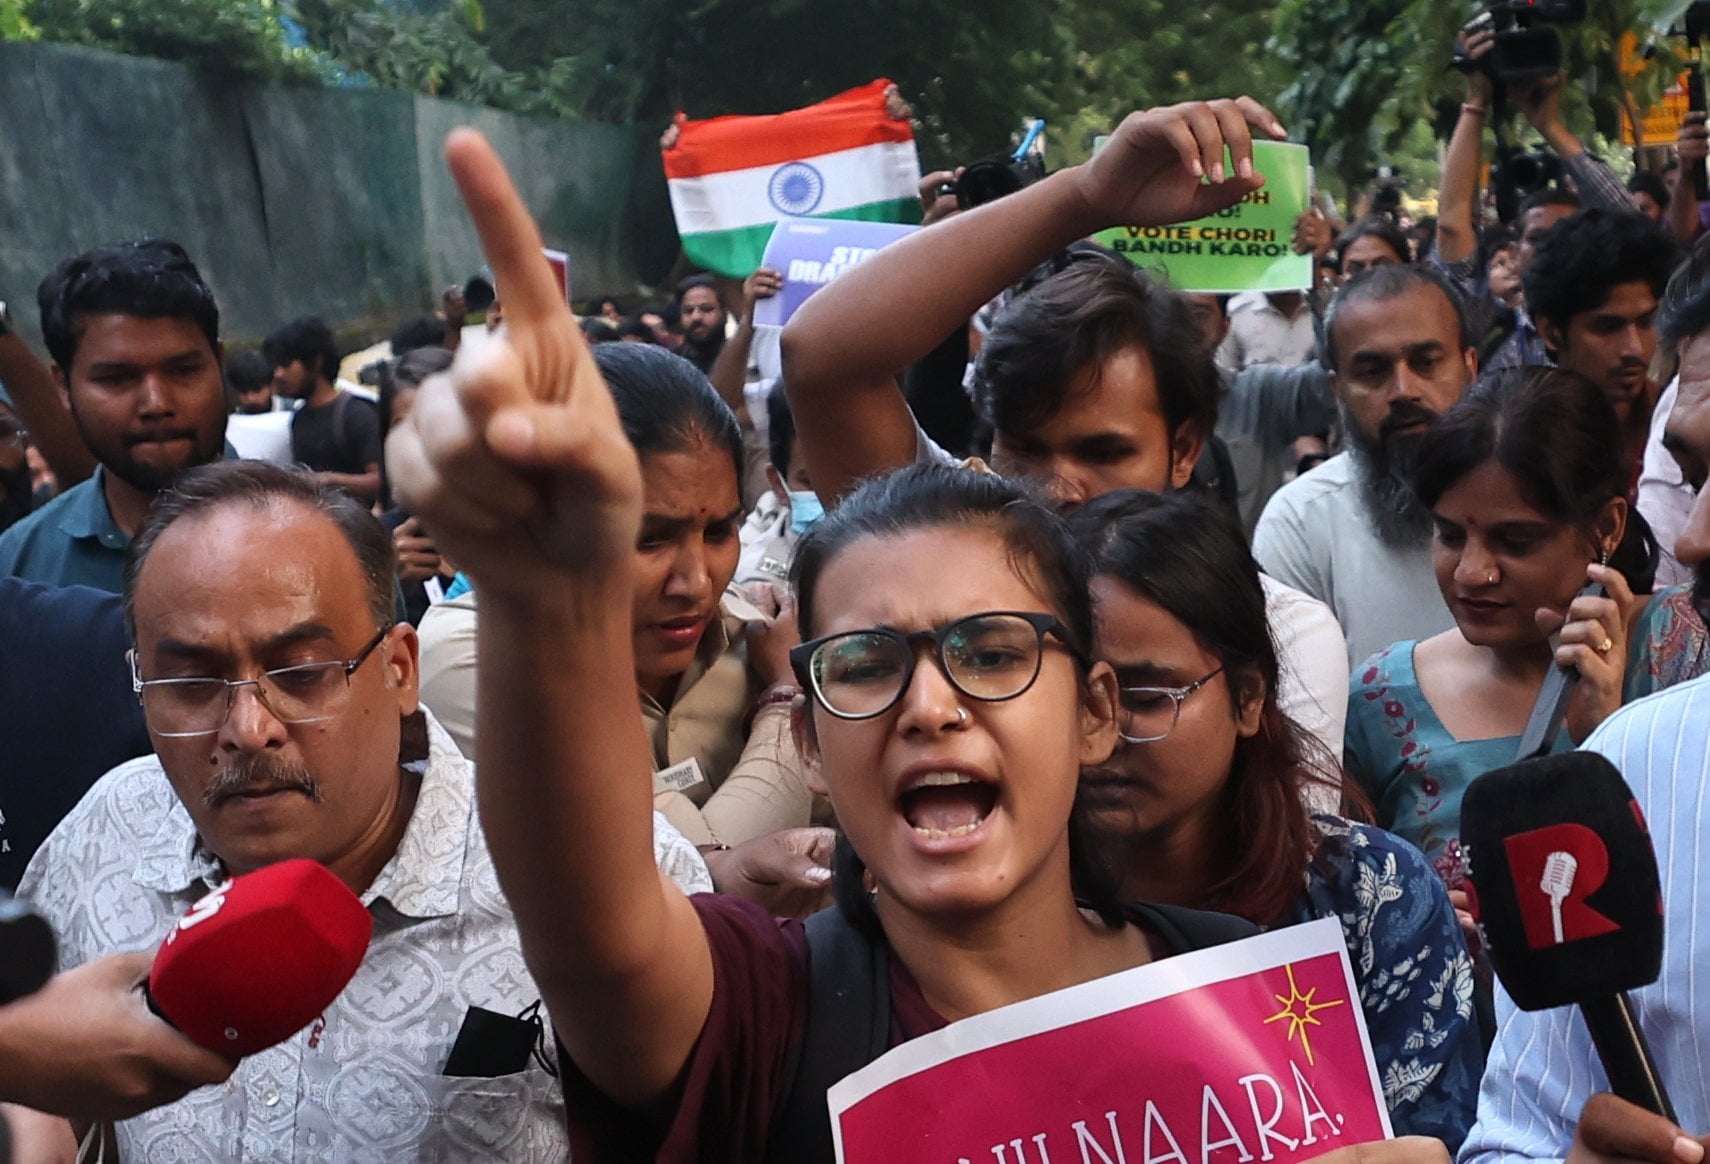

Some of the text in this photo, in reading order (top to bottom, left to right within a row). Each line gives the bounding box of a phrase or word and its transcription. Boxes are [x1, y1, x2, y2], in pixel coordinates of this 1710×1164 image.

[1126, 226, 1276, 242] VOTE CHORI
[1112, 239, 1288, 257] BANDH KARO!
